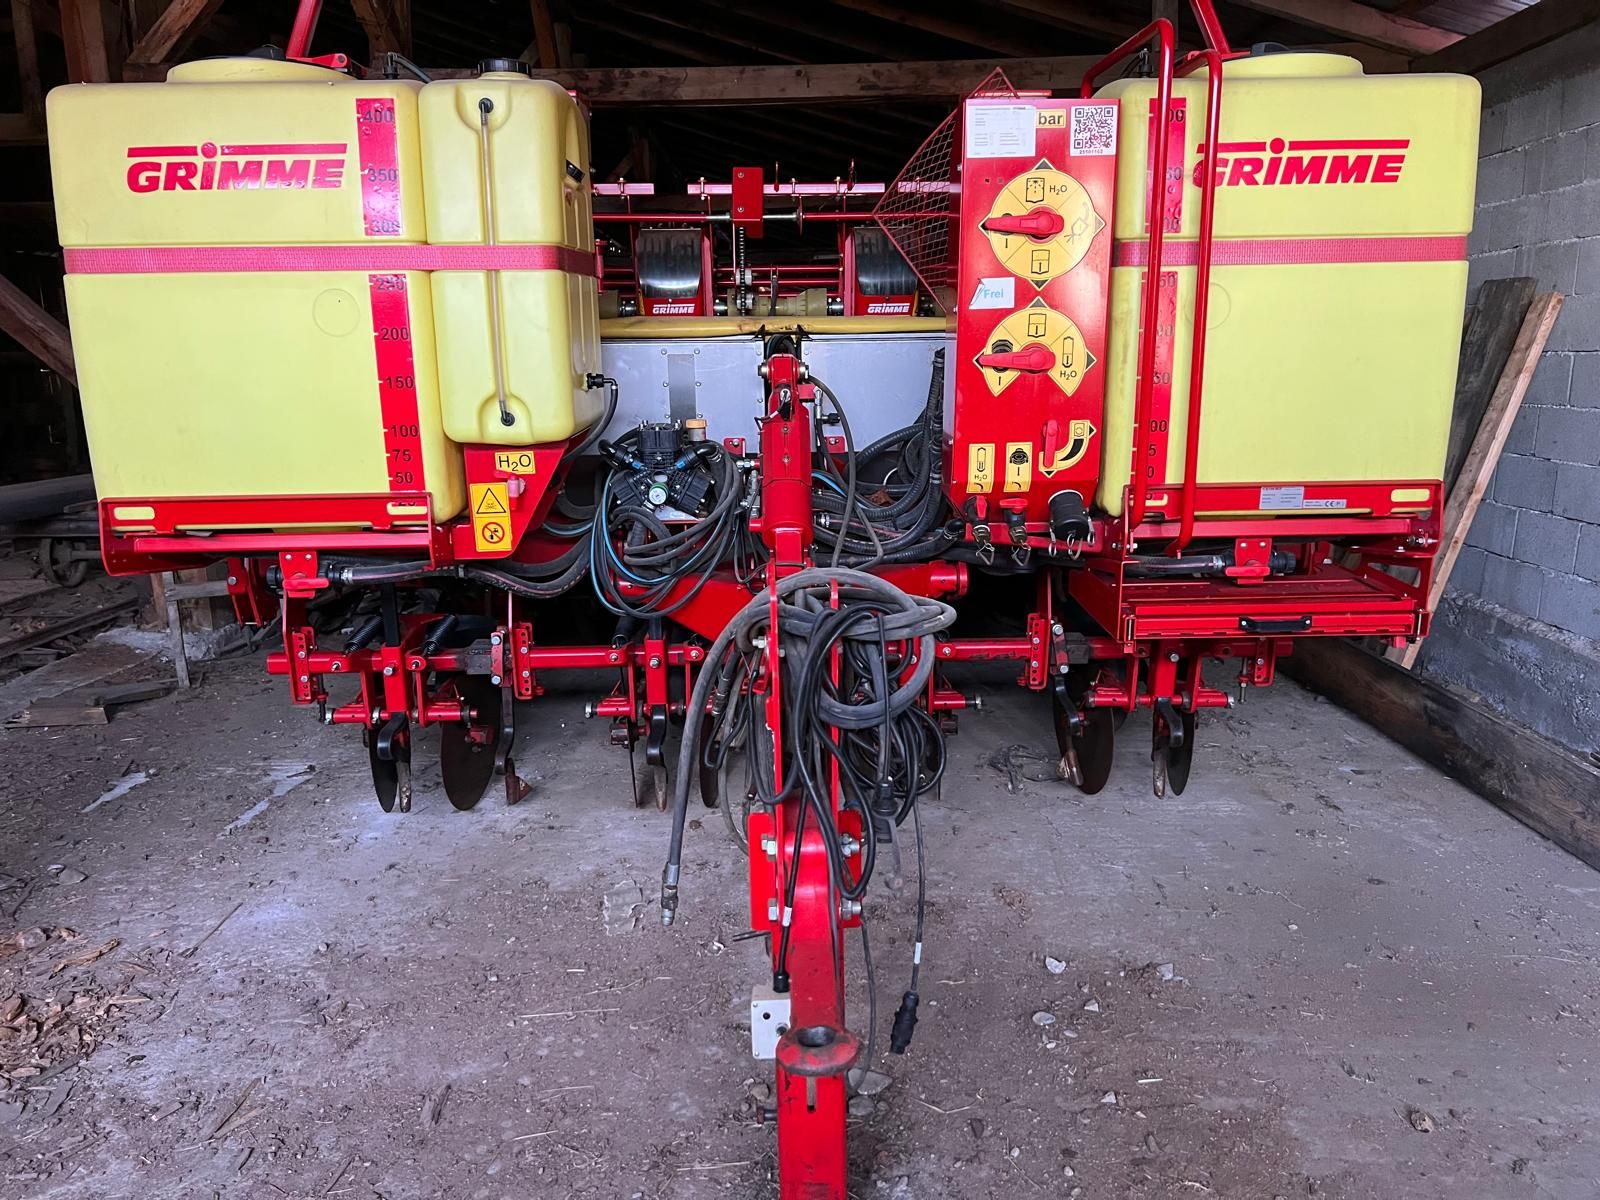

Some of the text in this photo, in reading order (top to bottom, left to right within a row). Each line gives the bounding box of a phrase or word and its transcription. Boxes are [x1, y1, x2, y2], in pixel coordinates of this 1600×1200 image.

[363, 109, 394, 123] 400
[1038, 113, 1064, 125] bar
[127, 142, 345, 193] GRIMME
[1192, 137, 1406, 188] GRIMME
[367, 168, 398, 183] 350
[652, 303, 695, 315] GRIMME
[867, 302, 910, 314] GRIMME
[380, 327, 409, 341] 200
[386, 376, 415, 389] 150
[390, 424, 419, 438] 100
[392, 449, 412, 462] 75
[395, 472, 414, 484] 50
